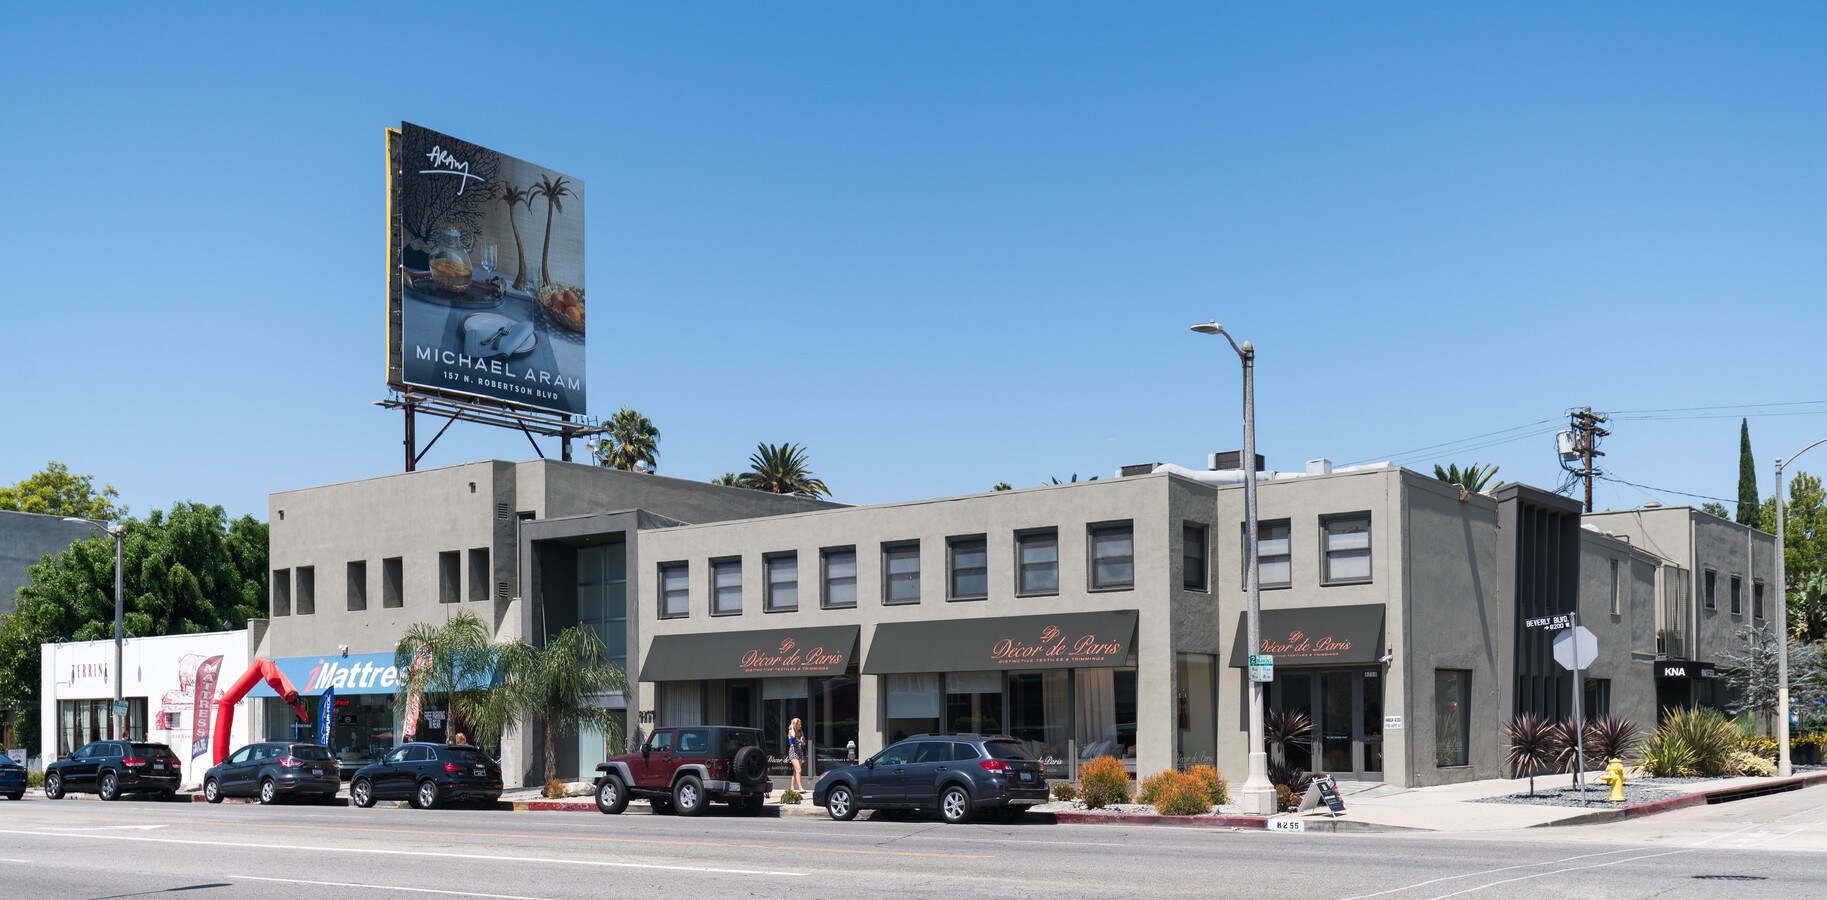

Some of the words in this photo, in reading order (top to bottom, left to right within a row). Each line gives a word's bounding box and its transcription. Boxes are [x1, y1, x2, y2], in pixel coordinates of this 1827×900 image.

[416, 345, 516, 378] MICHAEL
[524, 368, 581, 392] ARAM
[443, 371, 459, 382] 157
[464, 375, 474, 385] N.
[478, 377, 533, 396] ROBERTSON
[536, 389, 559, 401] BLVD
[1526, 617, 1551, 628] BEVERLY
[990, 637, 1044, 659] Décor
[1045, 636, 1068, 656] de
[1068, 634, 1122, 656] Paris
[1294, 637, 1311, 652] de
[1312, 636, 1353, 652] Paris
[739, 649, 783, 668] Décor
[782, 648, 801, 666] de
[801, 646, 844, 666] Paris
[72, 663, 108, 679] TERRINE
[1664, 667, 1686, 677] KNA
[197, 663, 218, 737] MATTRESS
[192, 738, 207, 755] SALE
[1043, 755, 1064, 765] Paris
[1277, 821, 1299, 830] 8255
